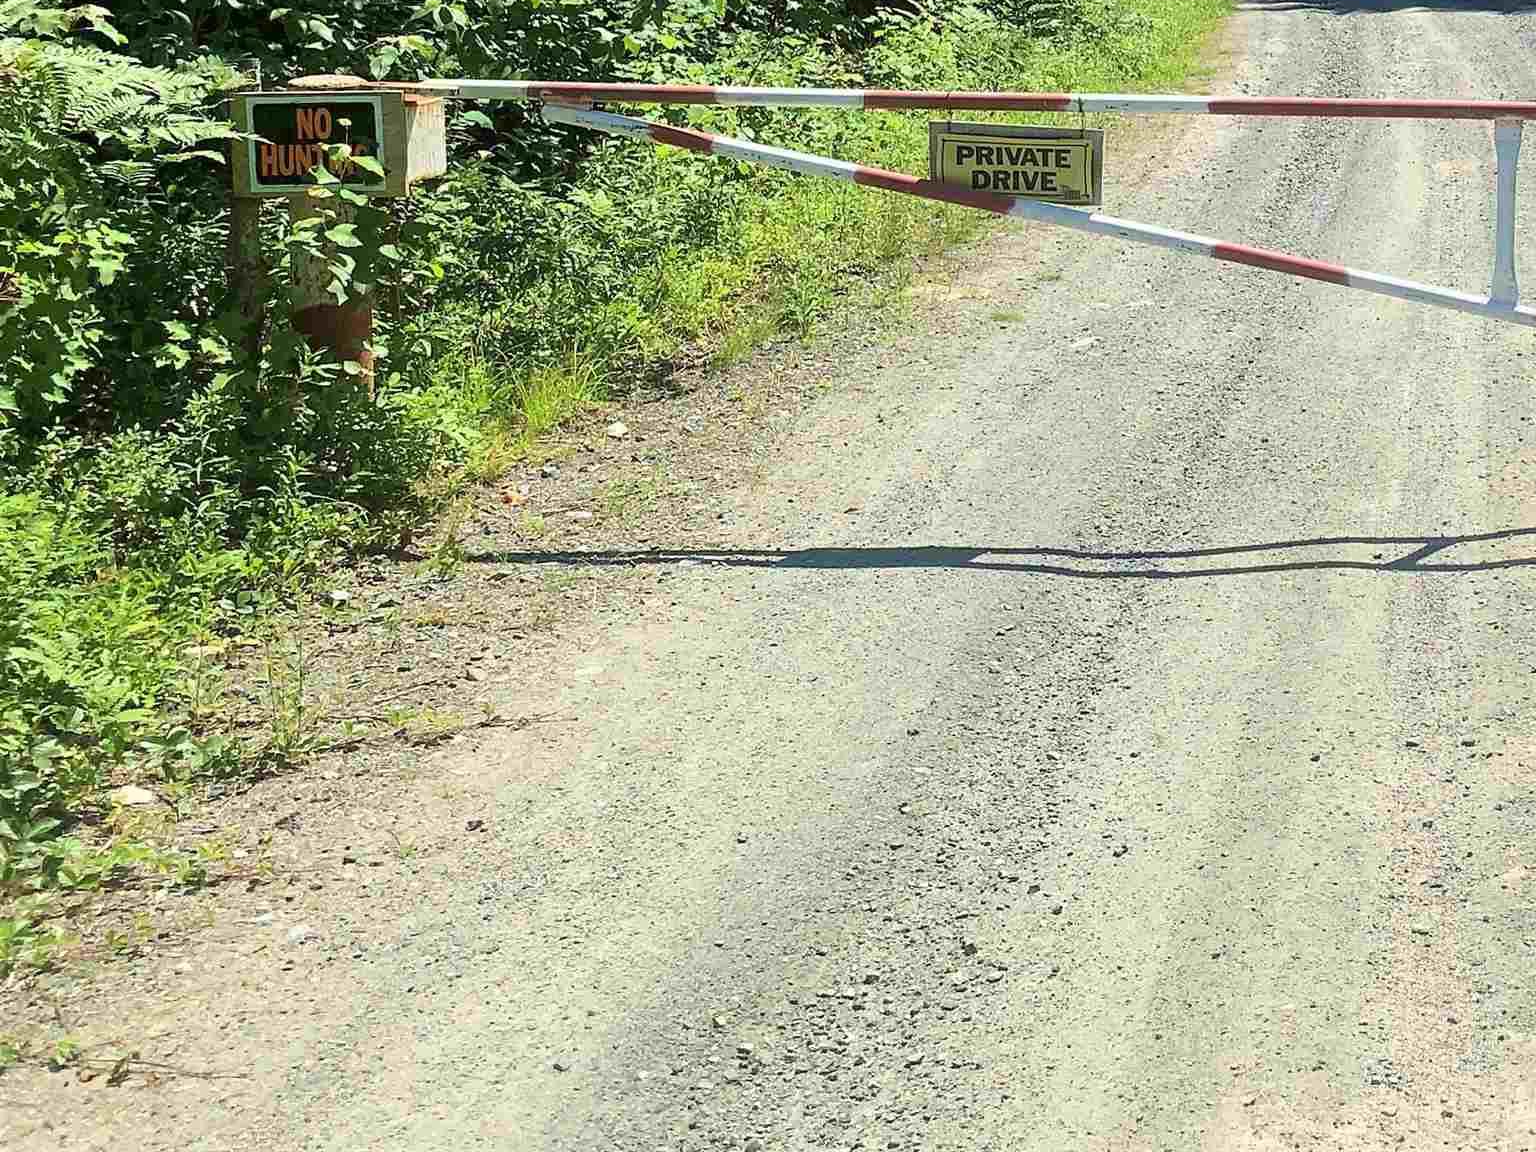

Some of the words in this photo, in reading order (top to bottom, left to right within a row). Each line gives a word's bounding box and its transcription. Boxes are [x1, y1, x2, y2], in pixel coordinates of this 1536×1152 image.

[296, 107, 332, 140] NO
[956, 145, 1071, 168] PRIVATE
[972, 170, 1057, 191] DRIVE
